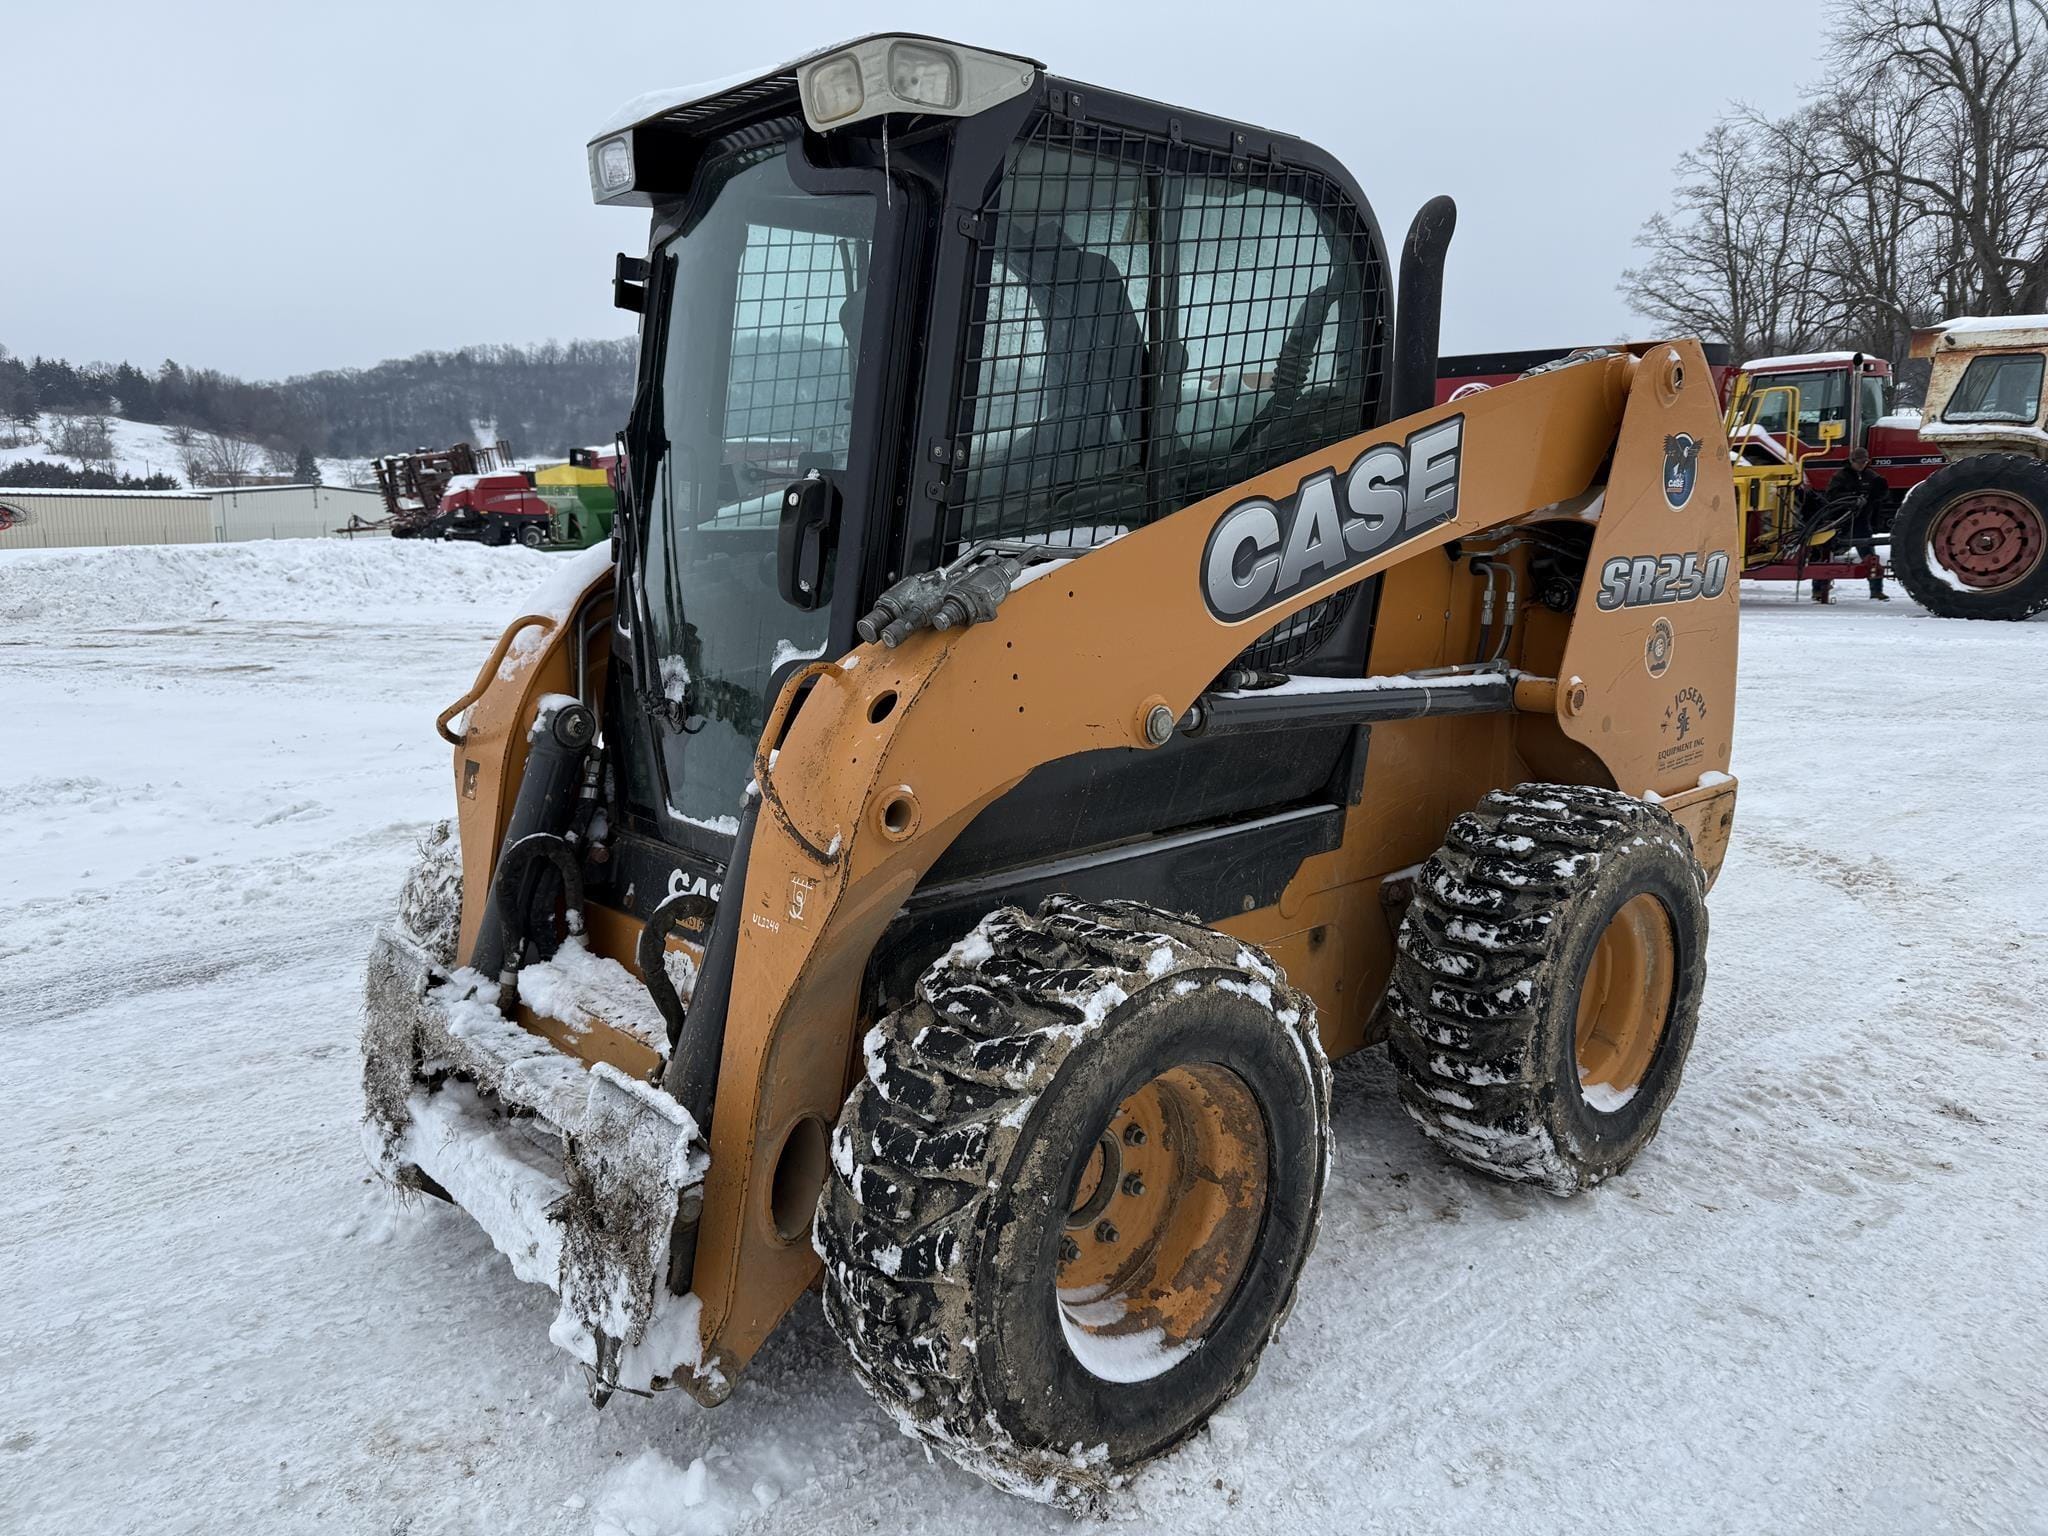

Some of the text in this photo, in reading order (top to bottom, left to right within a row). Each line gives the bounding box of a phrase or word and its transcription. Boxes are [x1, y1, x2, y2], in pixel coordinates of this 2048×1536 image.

[1207, 423, 1461, 615] CASE
[1598, 553, 1730, 609] SR250
[1675, 687, 1707, 720] JOSEPH
[1658, 737, 1705, 760] EQUIPMENT INC
[668, 868, 723, 902] CAS
